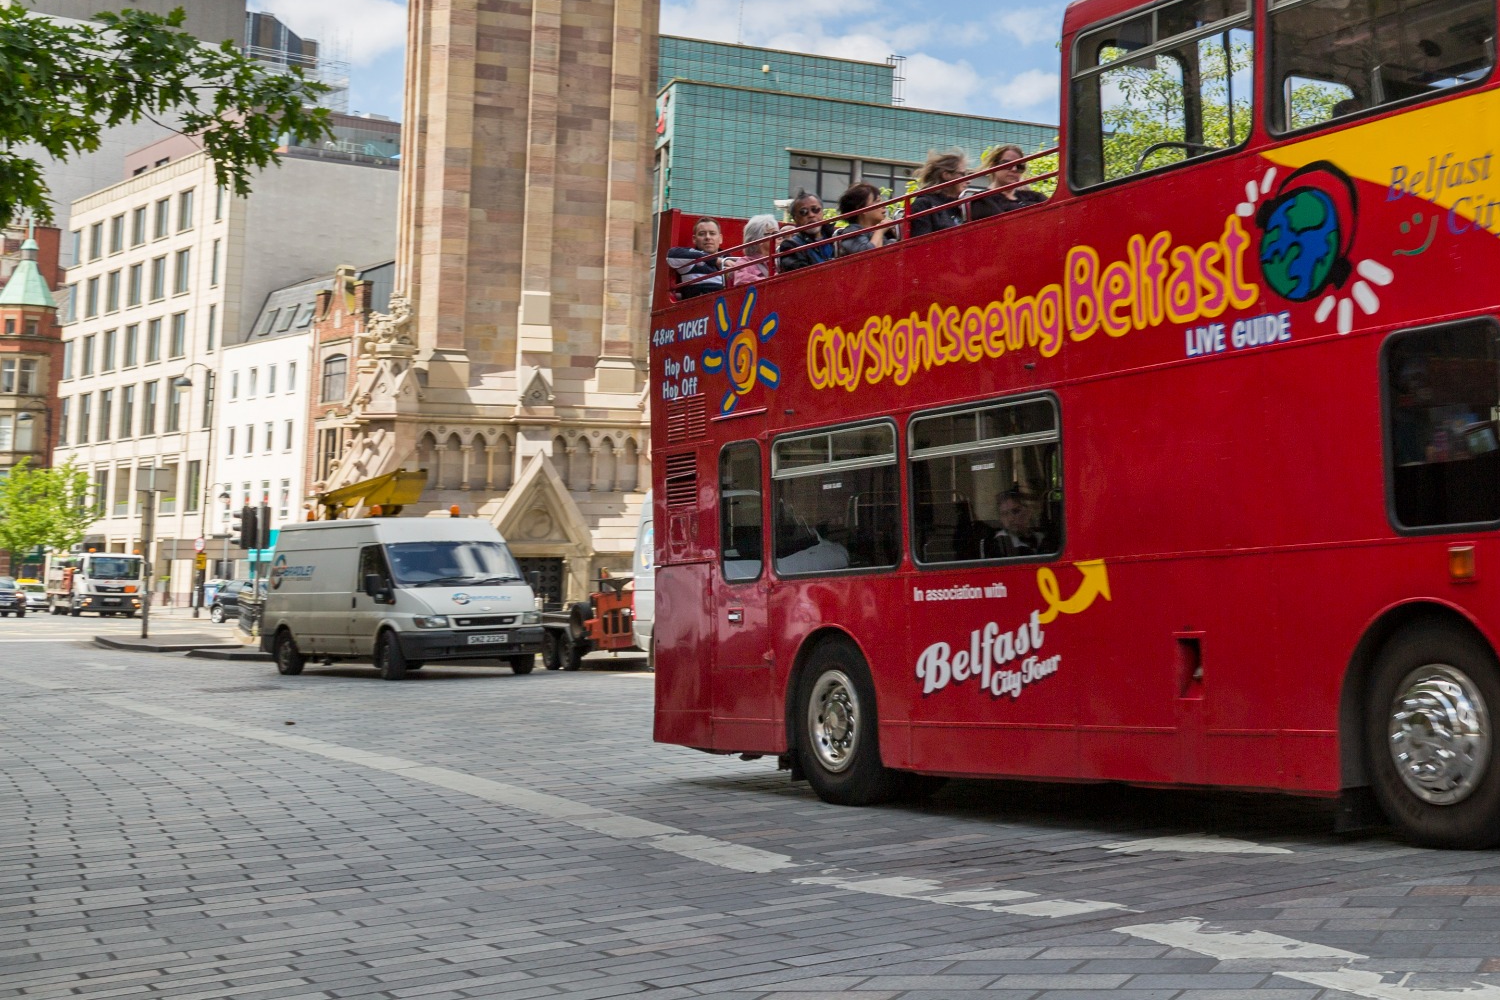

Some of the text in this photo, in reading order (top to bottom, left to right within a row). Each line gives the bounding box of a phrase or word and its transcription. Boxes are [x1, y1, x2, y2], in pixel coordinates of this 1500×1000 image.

[1385, 149, 1495, 203] Belfast
[1064, 214, 1259, 341] Belfast
[677, 316, 709, 341] TICKET
[1185, 310, 1292, 357] LIVE GUIDE
[662, 376, 698, 401] Hop Off
[664, 355, 696, 380] Hop On
[914, 582, 1008, 601] In association with
[915, 609, 1045, 694] Belfast
[991, 655, 1062, 698] City Tour
